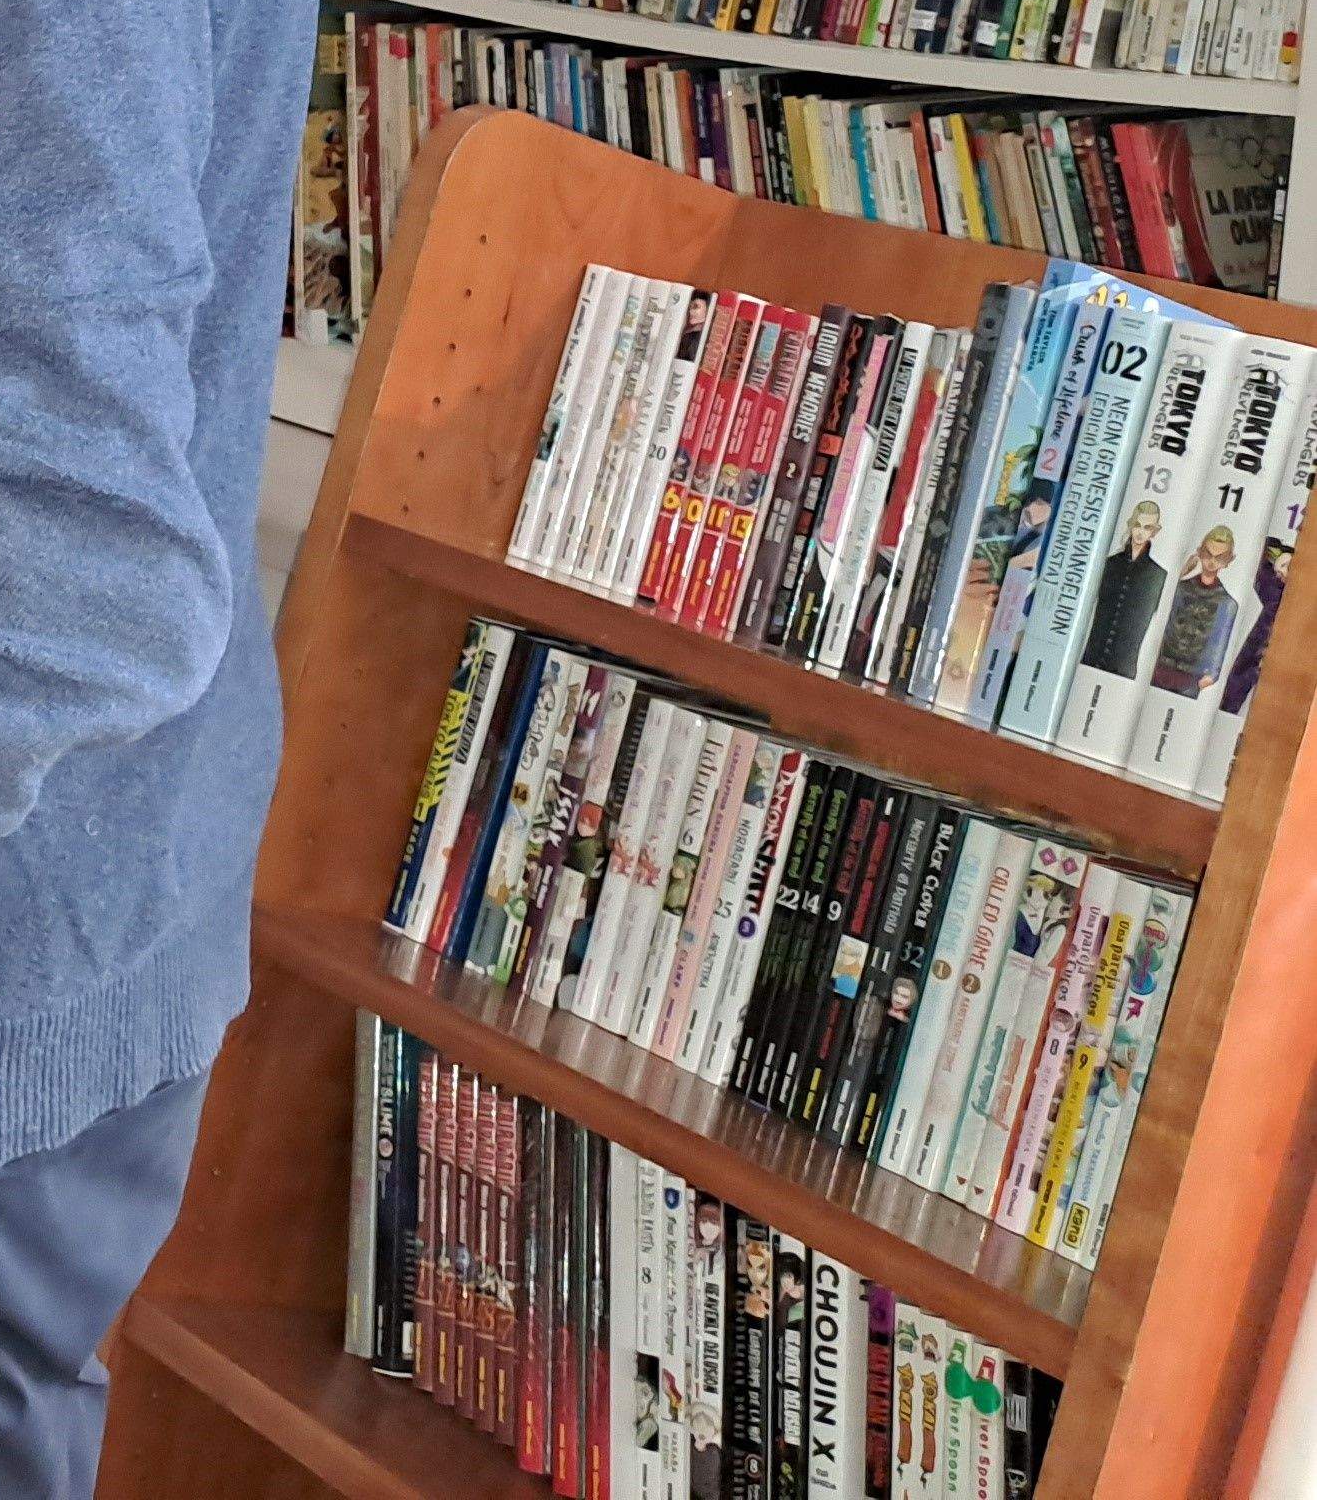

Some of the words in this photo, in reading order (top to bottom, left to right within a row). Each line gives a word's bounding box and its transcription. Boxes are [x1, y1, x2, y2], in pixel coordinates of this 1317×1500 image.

[812, 320, 840, 368] LIQUID
[1100, 340, 1149, 382] 02
[791, 369, 826, 443] MEMORIES
[1101, 395, 1133, 447] NEON
[1147, 366, 1180, 450] REVENGERS
[1160, 368, 1205, 457] TOKYO
[1220, 384, 1254, 467] REVENGERS
[1233, 372, 1279, 475] TOKYO
[648, 444, 666, 461] 20
[1041, 447, 1056, 471] 2
[1079, 447, 1118, 524] GENESIS
[1142, 465, 1173, 494] 13
[1218, 483, 1246, 513] 11
[1046, 525, 1096, 635] EVANGELION
[722, 817, 751, 884] NORAGAMI
[899, 819, 926, 871] Moriarty
[928, 822, 955, 871] BLACK
[776, 884, 799, 910] 22
[802, 891, 820, 915] 14
[826, 901, 842, 921] 9
[912, 873, 941, 928] CLOVER
[981, 865, 1012, 923] CALLED
[870, 947, 890, 973] 11
[899, 941, 925, 968] 32
[966, 924, 994, 969] GAME
[1071, 930, 1100, 975] pareja
[1097, 943, 1127, 989] pareja
[1053, 958, 1079, 1002] Cucos
[1082, 973, 1108, 1016] Cucos
[378, 1087, 394, 1135] SLIME
[703, 1281, 720, 1337] HEAVENLY
[702, 1338, 719, 1395] DELUSION
[783, 1328, 802, 1388] HEAVENLY
[811, 1263, 840, 1427] CHOUJIN
[783, 1388, 802, 1446] DELUSION
[812, 1436, 836, 1464] X
[946, 1439, 961, 1494] Spoon
[976, 1457, 990, 1500] Spoo
